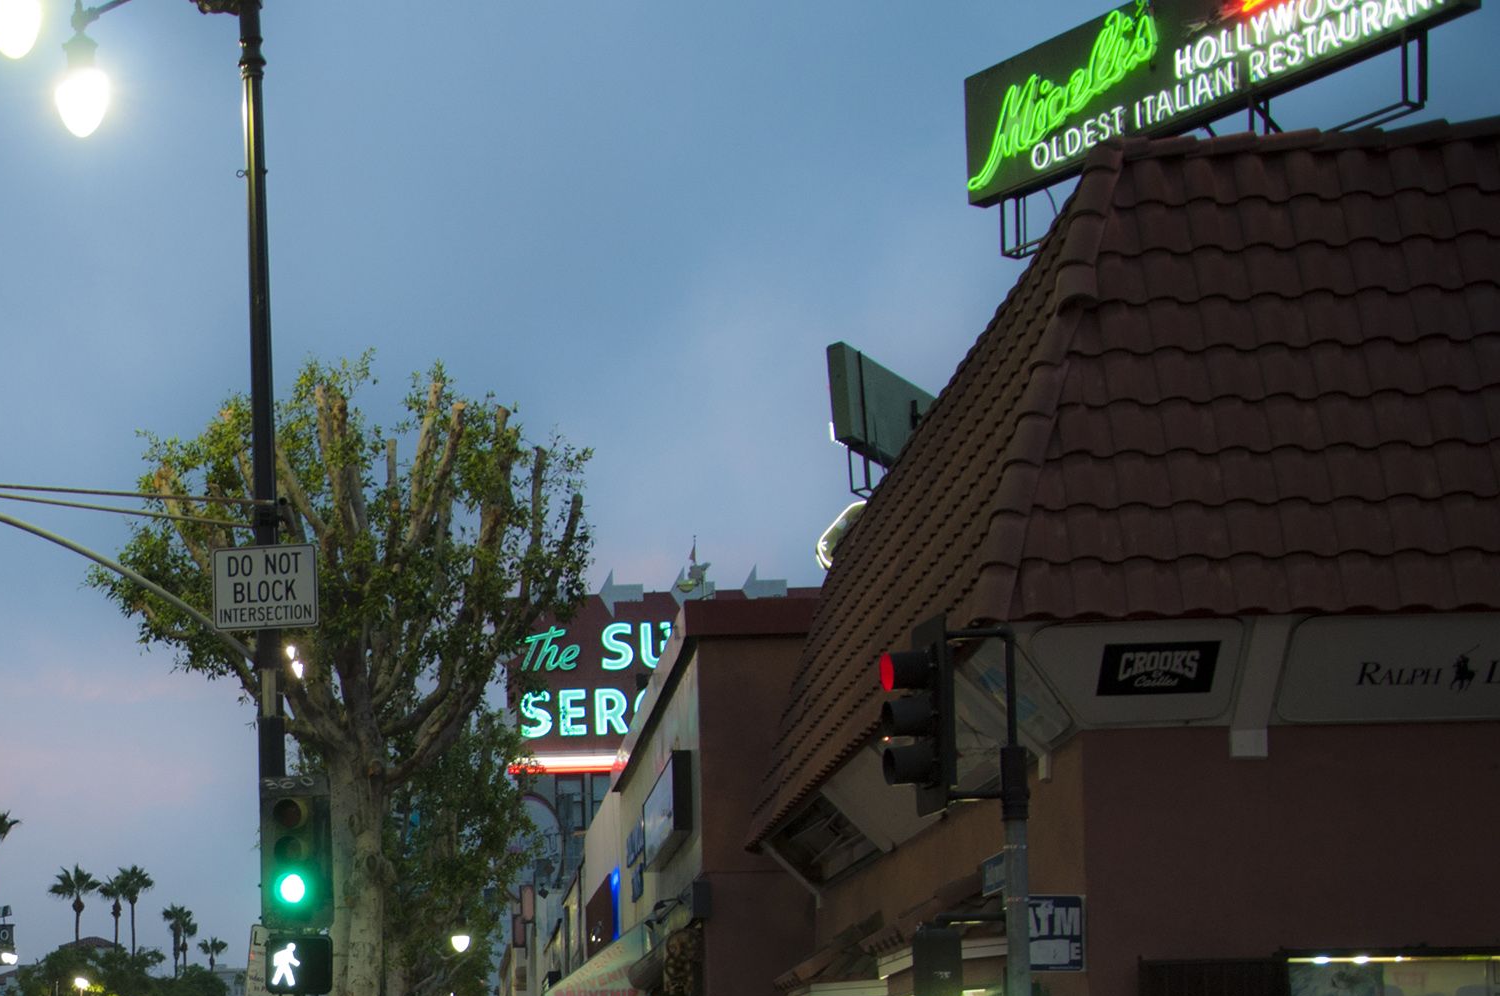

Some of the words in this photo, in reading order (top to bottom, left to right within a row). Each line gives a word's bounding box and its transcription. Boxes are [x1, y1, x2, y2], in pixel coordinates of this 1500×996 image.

[1031, 105, 1126, 170] OLDEST
[1135, 60, 1238, 130] ITALIAN
[1249, 0, 1444, 82] RESTAURA
[227, 554, 253, 578] DO
[265, 551, 302, 576] NOT
[233, 578, 298, 604] BLOCK
[219, 603, 313, 625] INTERSECTION
[516, 625, 581, 672] The
[1117, 650, 1201, 682] CROOKS
[520, 687, 649, 739] SER
